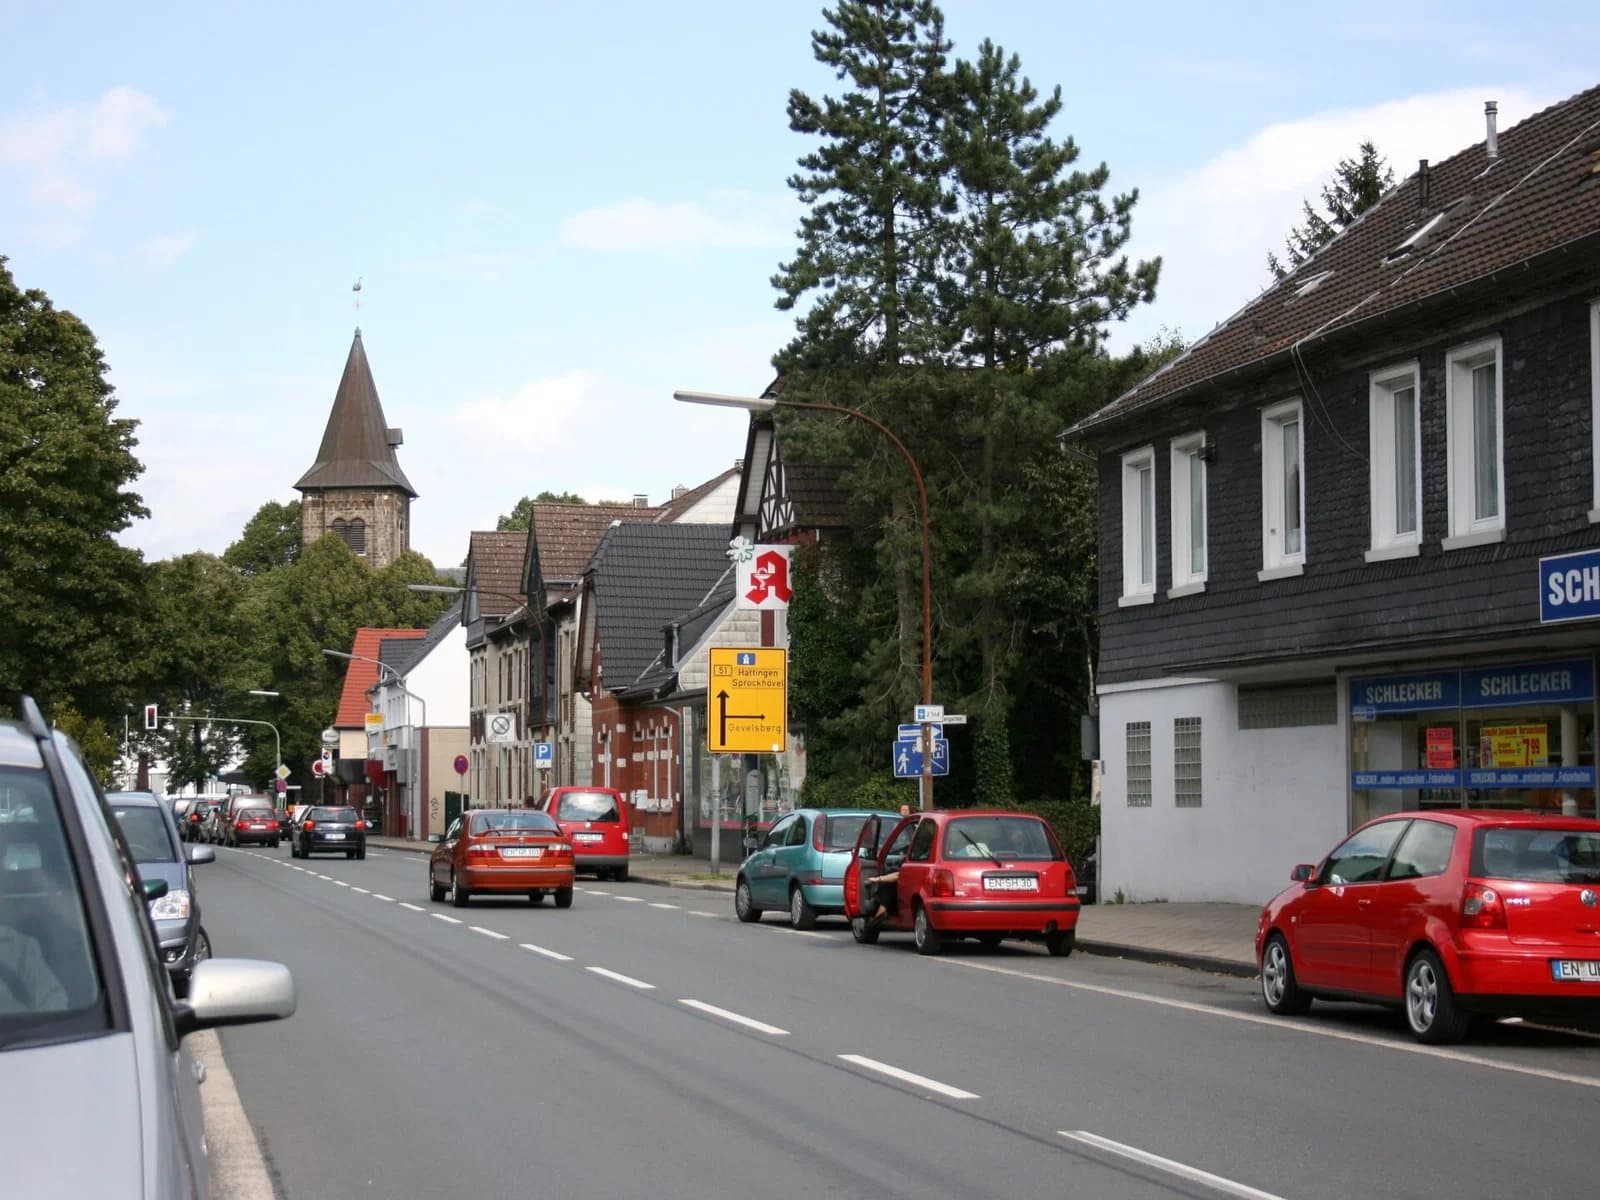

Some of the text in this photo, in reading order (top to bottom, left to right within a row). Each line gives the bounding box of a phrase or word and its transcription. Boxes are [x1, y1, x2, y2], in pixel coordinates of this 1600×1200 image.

[1548, 566, 1600, 606] SCH
[718, 667, 728, 675] 51
[738, 668, 779, 678] Hattingen
[1481, 671, 1572, 697] SCHLECKER
[1366, 681, 1442, 704] SCHLECKER
[728, 722, 782, 735] Gevelsberg
[538, 745, 549, 758] P
